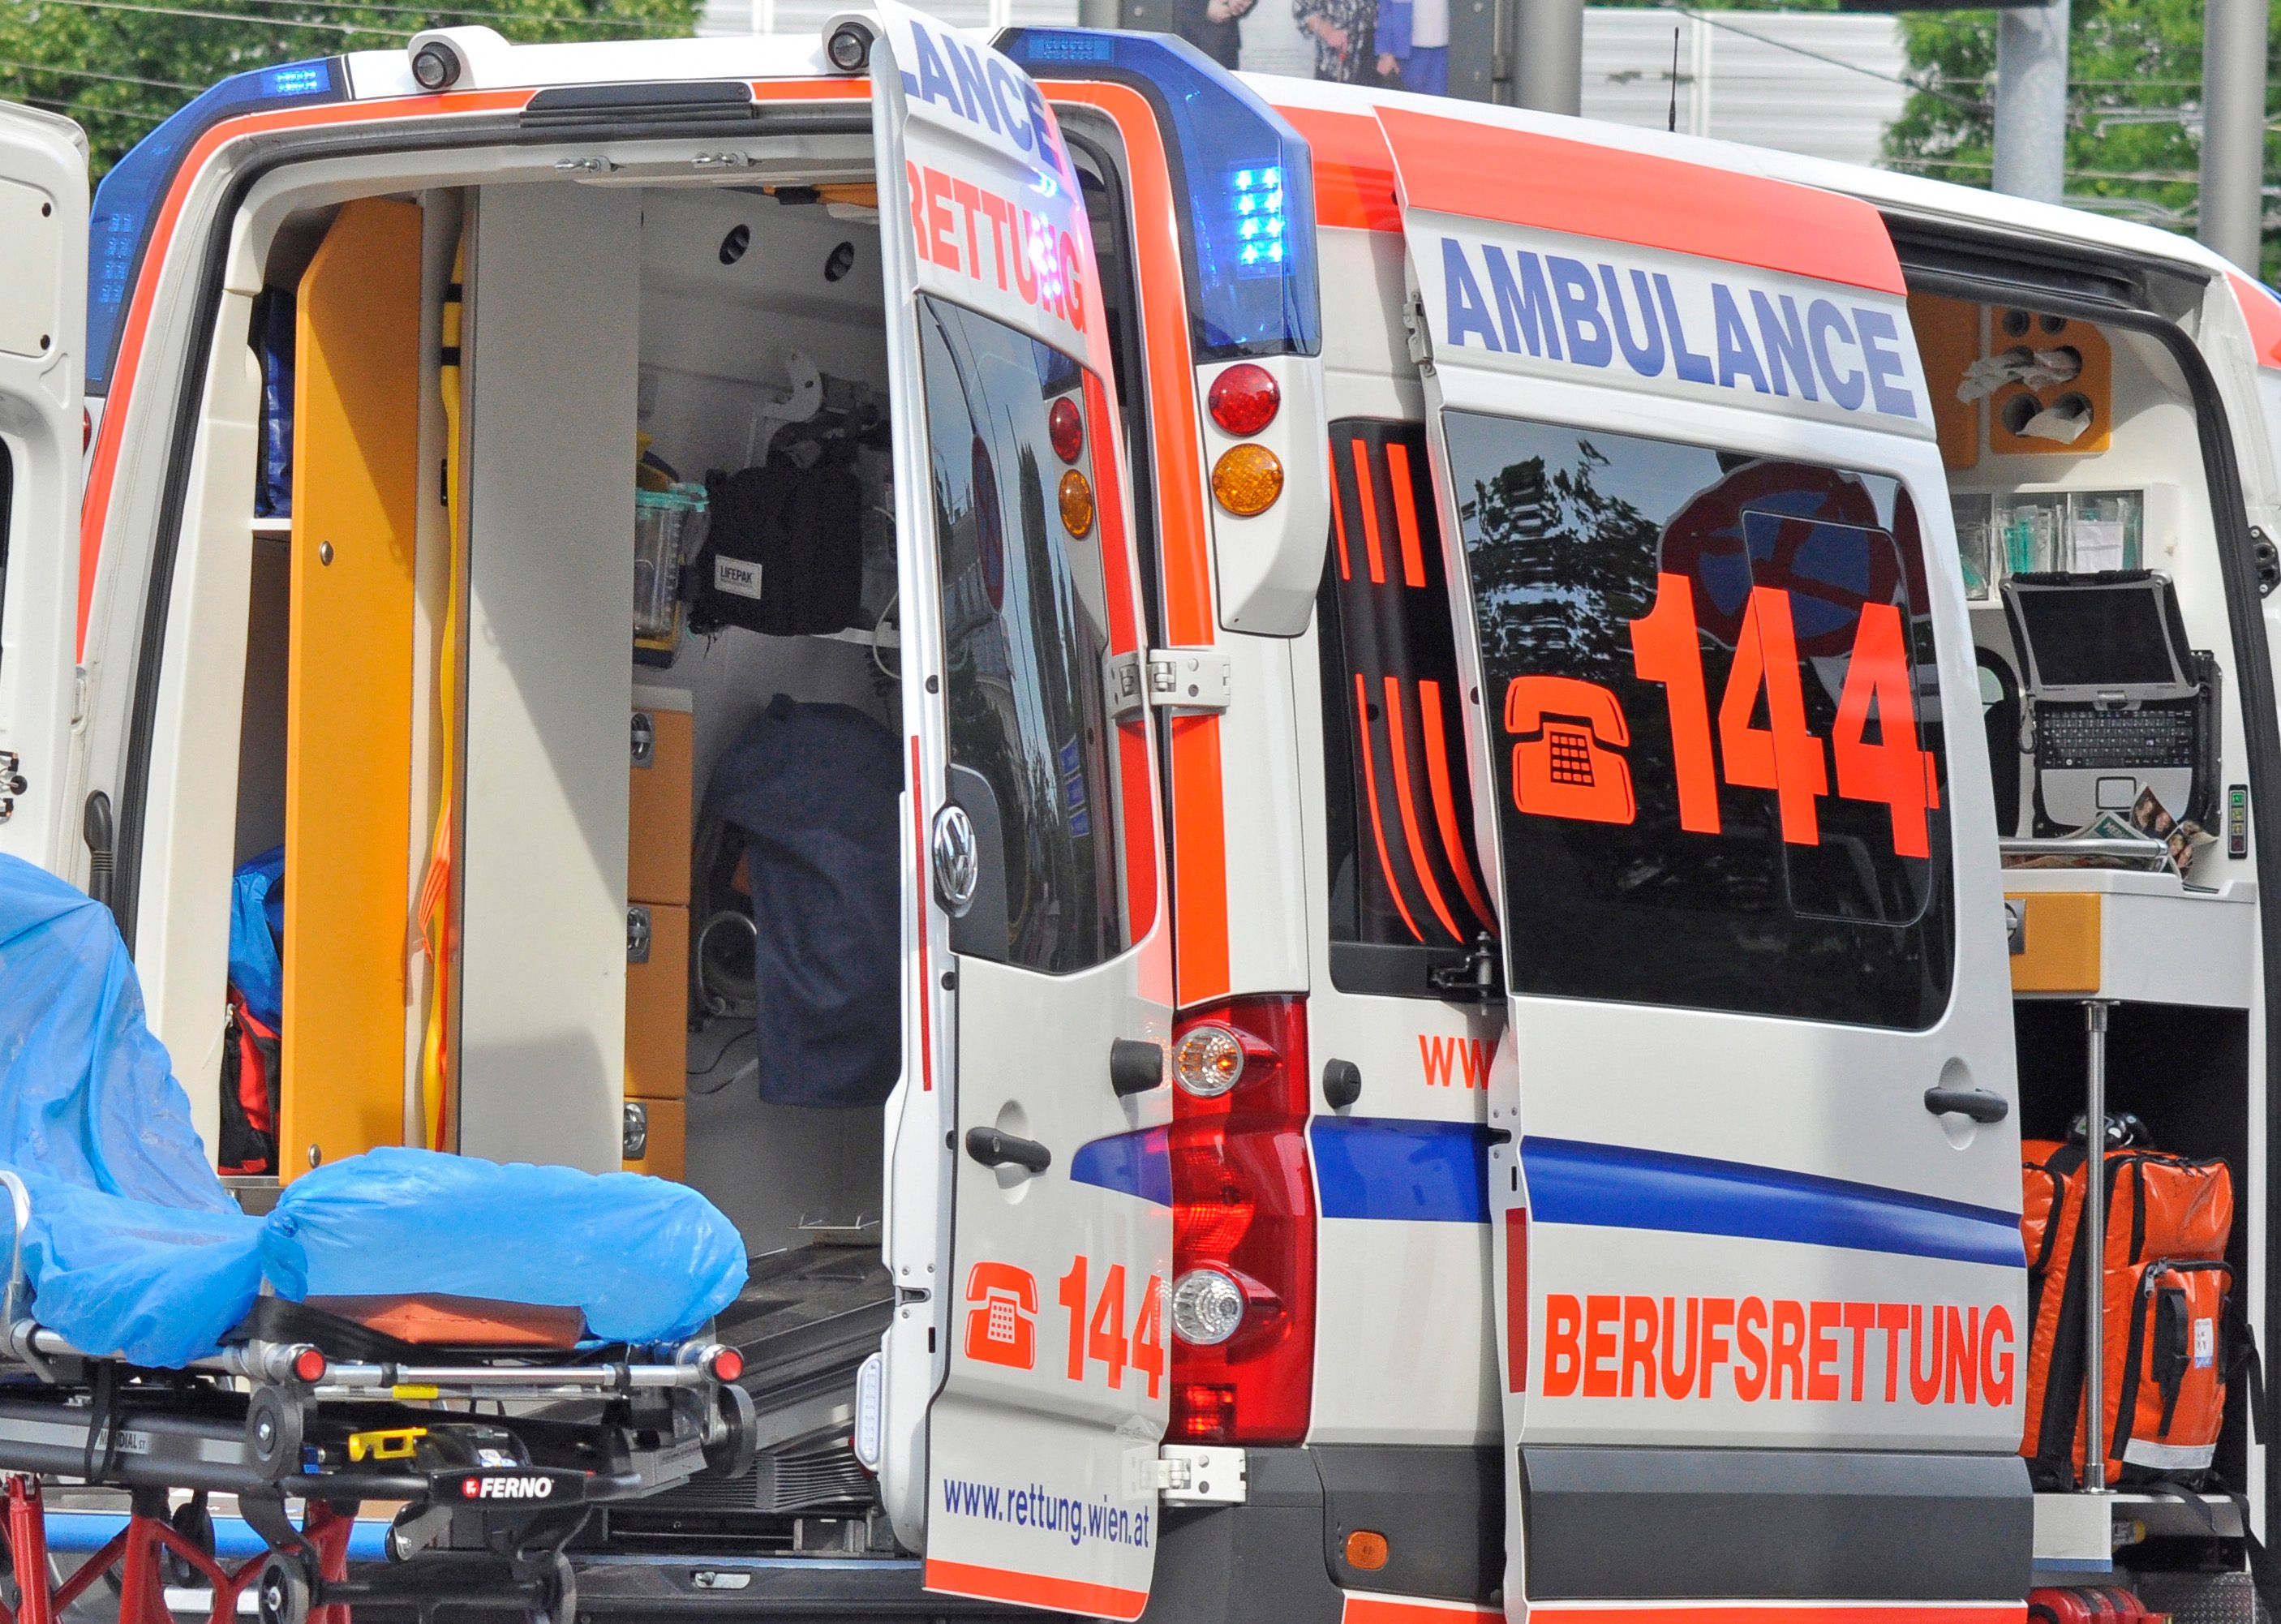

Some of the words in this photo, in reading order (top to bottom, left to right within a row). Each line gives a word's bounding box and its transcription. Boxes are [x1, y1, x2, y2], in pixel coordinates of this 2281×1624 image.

[1441, 237, 1918, 419] AMBULANCE
[720, 565, 754, 584] LIFEPAK
[1629, 572, 1939, 858] 144
[1058, 1253, 1165, 1400] 144
[1543, 1293, 2016, 1407] BERUFSRETTUNG
[99, 1430, 137, 1450] MDIAL
[479, 1476, 552, 1499] FERNO
[943, 1478, 1149, 1549] www.rettung.wien.at
